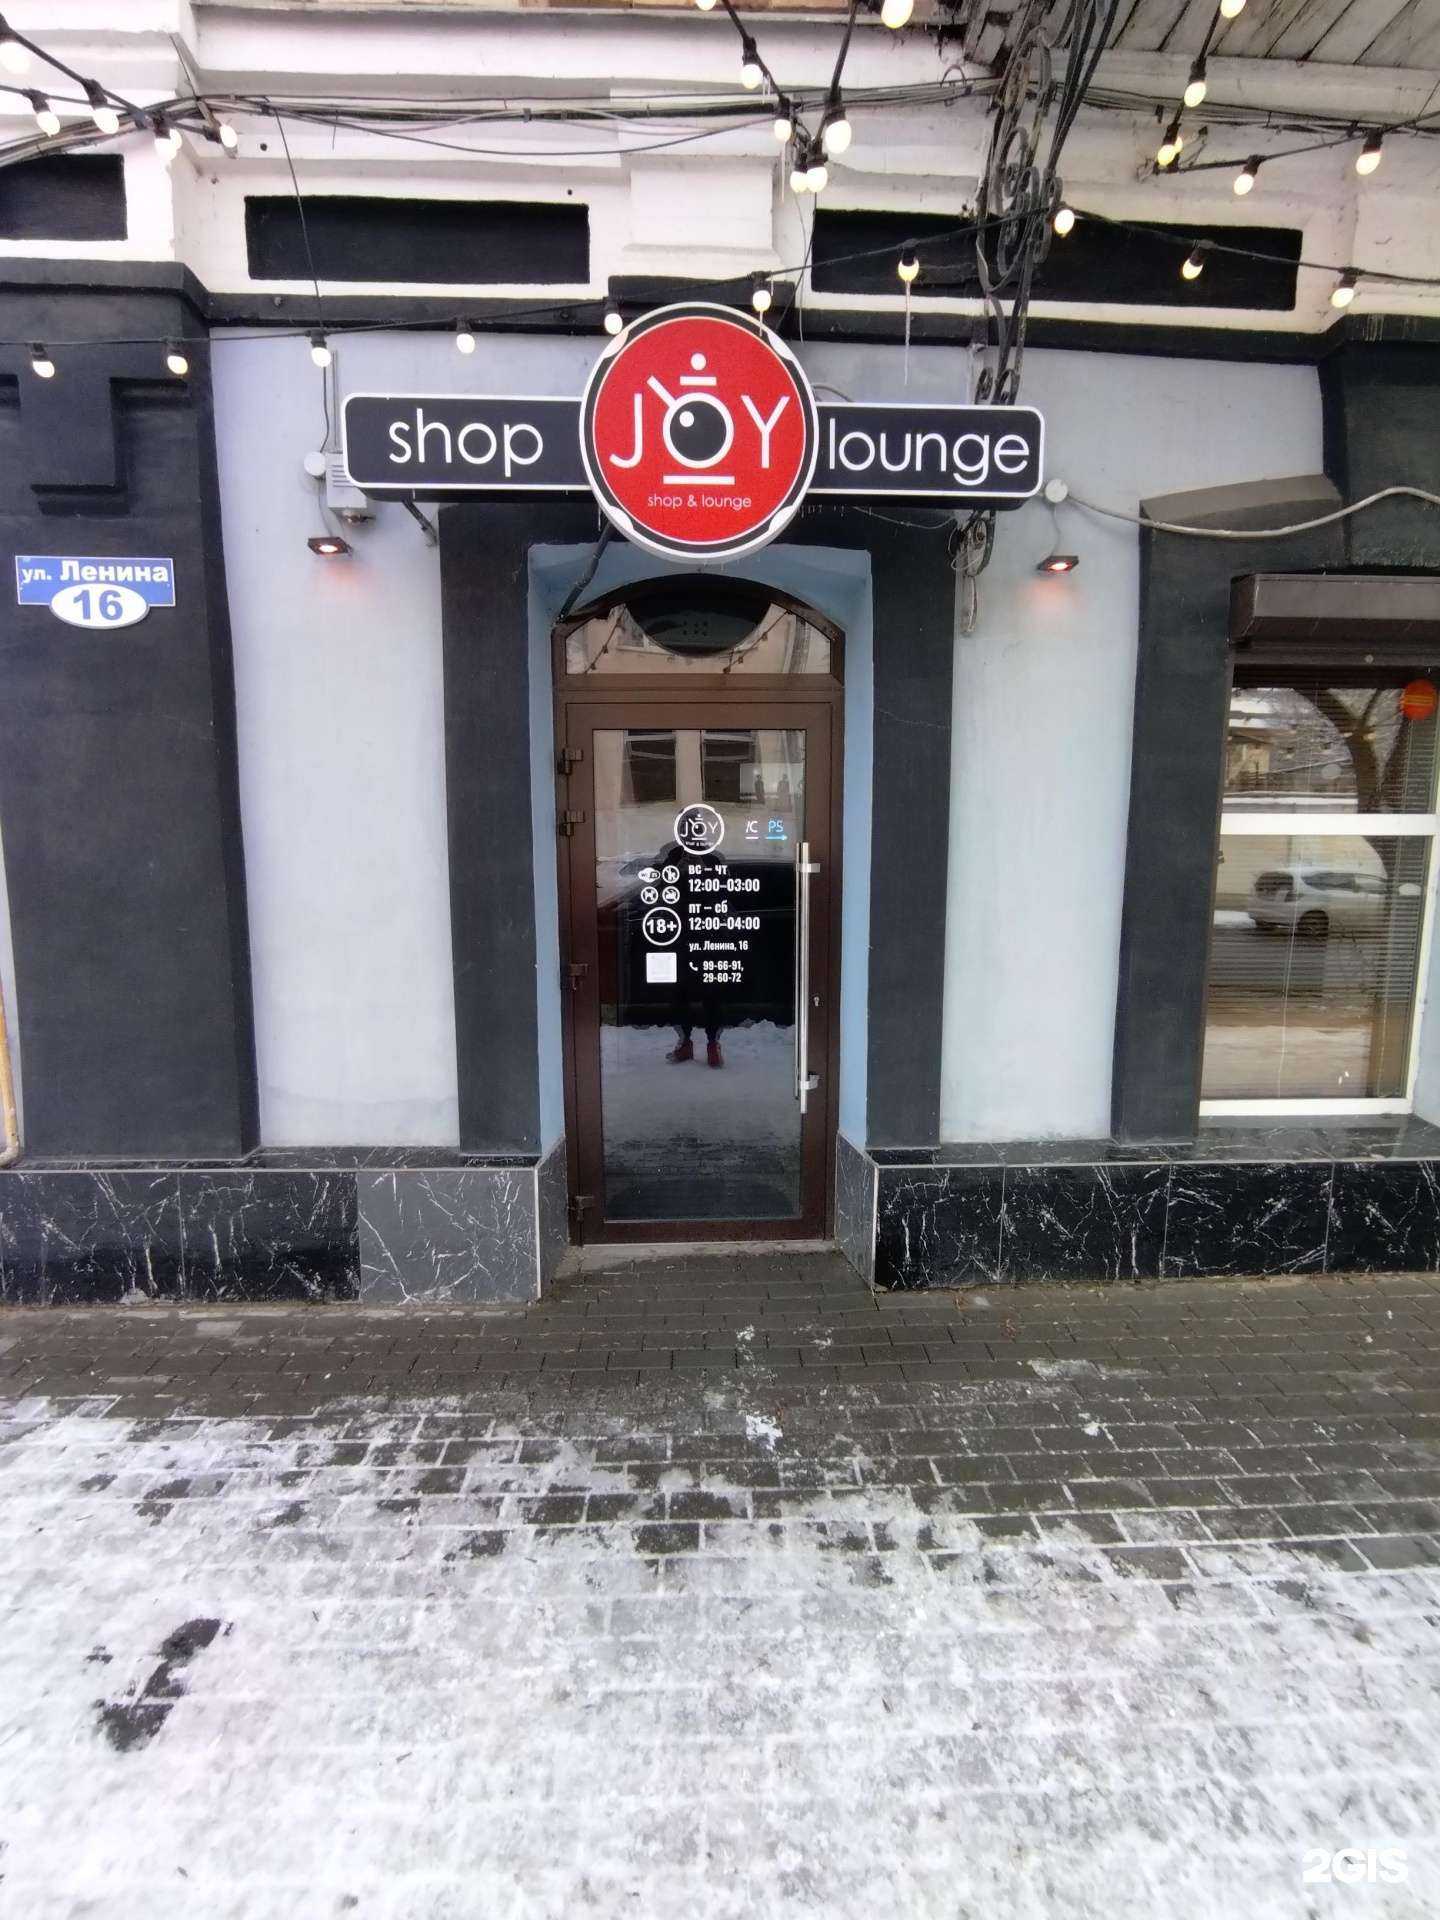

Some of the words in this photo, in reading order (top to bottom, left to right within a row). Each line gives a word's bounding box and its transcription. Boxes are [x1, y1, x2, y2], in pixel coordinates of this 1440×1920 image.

[609, 391, 790, 470] JOY
[388, 408, 544, 478] shop
[828, 417, 1029, 485] lounge
[647, 493, 682, 509] shop
[687, 494, 697, 507] &
[701, 494, 752, 511] lounge
[21, 567, 52, 583] ул.
[60, 560, 169, 582] Ленина
[73, 589, 123, 620] 16
[680, 820, 718, 838] JOY
[768, 820, 784, 833] PS
[646, 919, 677, 934] 18+
[688, 942, 702, 952] ул.
[738, 941, 748, 951] 16
